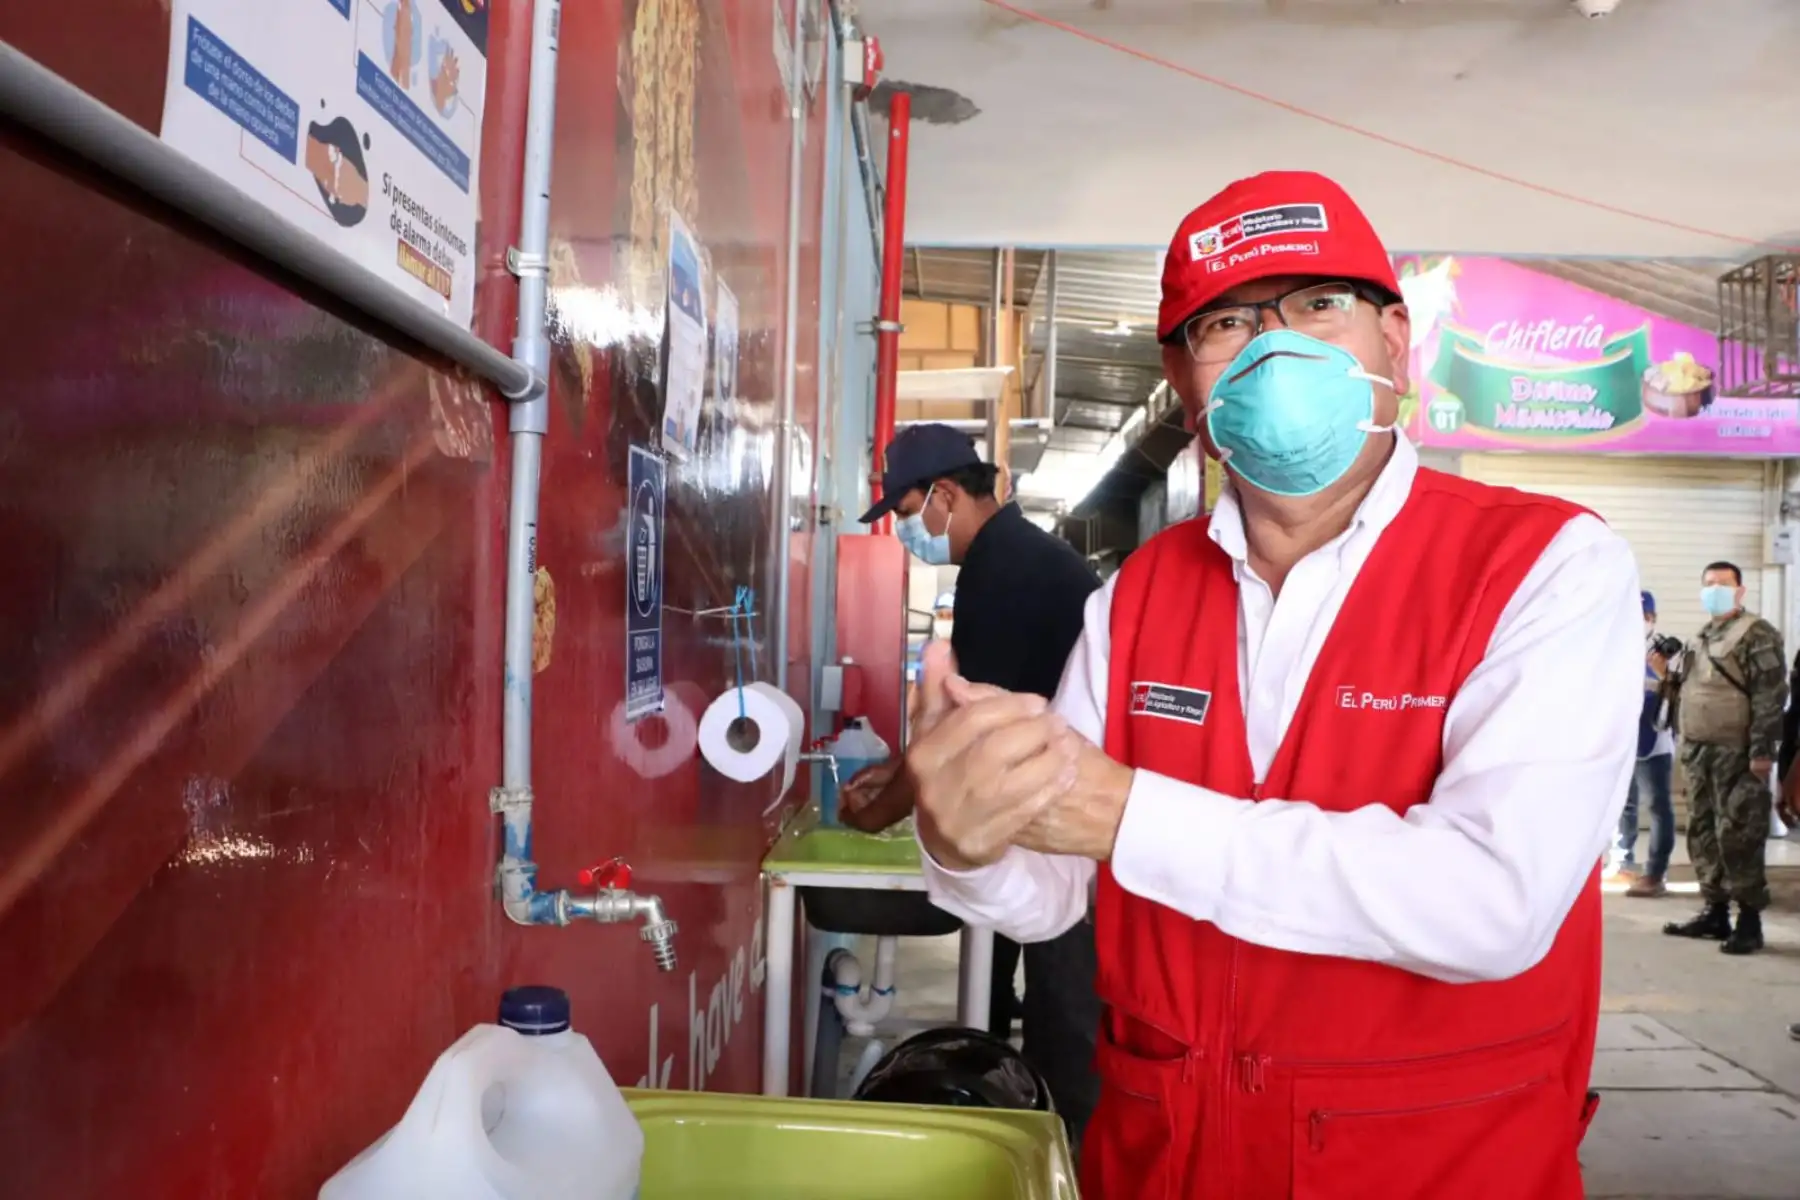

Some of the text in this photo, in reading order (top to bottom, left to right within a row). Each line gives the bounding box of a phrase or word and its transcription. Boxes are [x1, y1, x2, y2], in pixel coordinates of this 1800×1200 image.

[392, 184, 433, 231] presentas
[390, 208, 402, 235] de
[403, 220, 432, 257] alarma
[1484, 313, 1604, 359] Chiflería
[1435, 411, 1456, 430] 01
[1361, 691, 1397, 710] PERÚ
[1400, 693, 1447, 710] PRIMER
